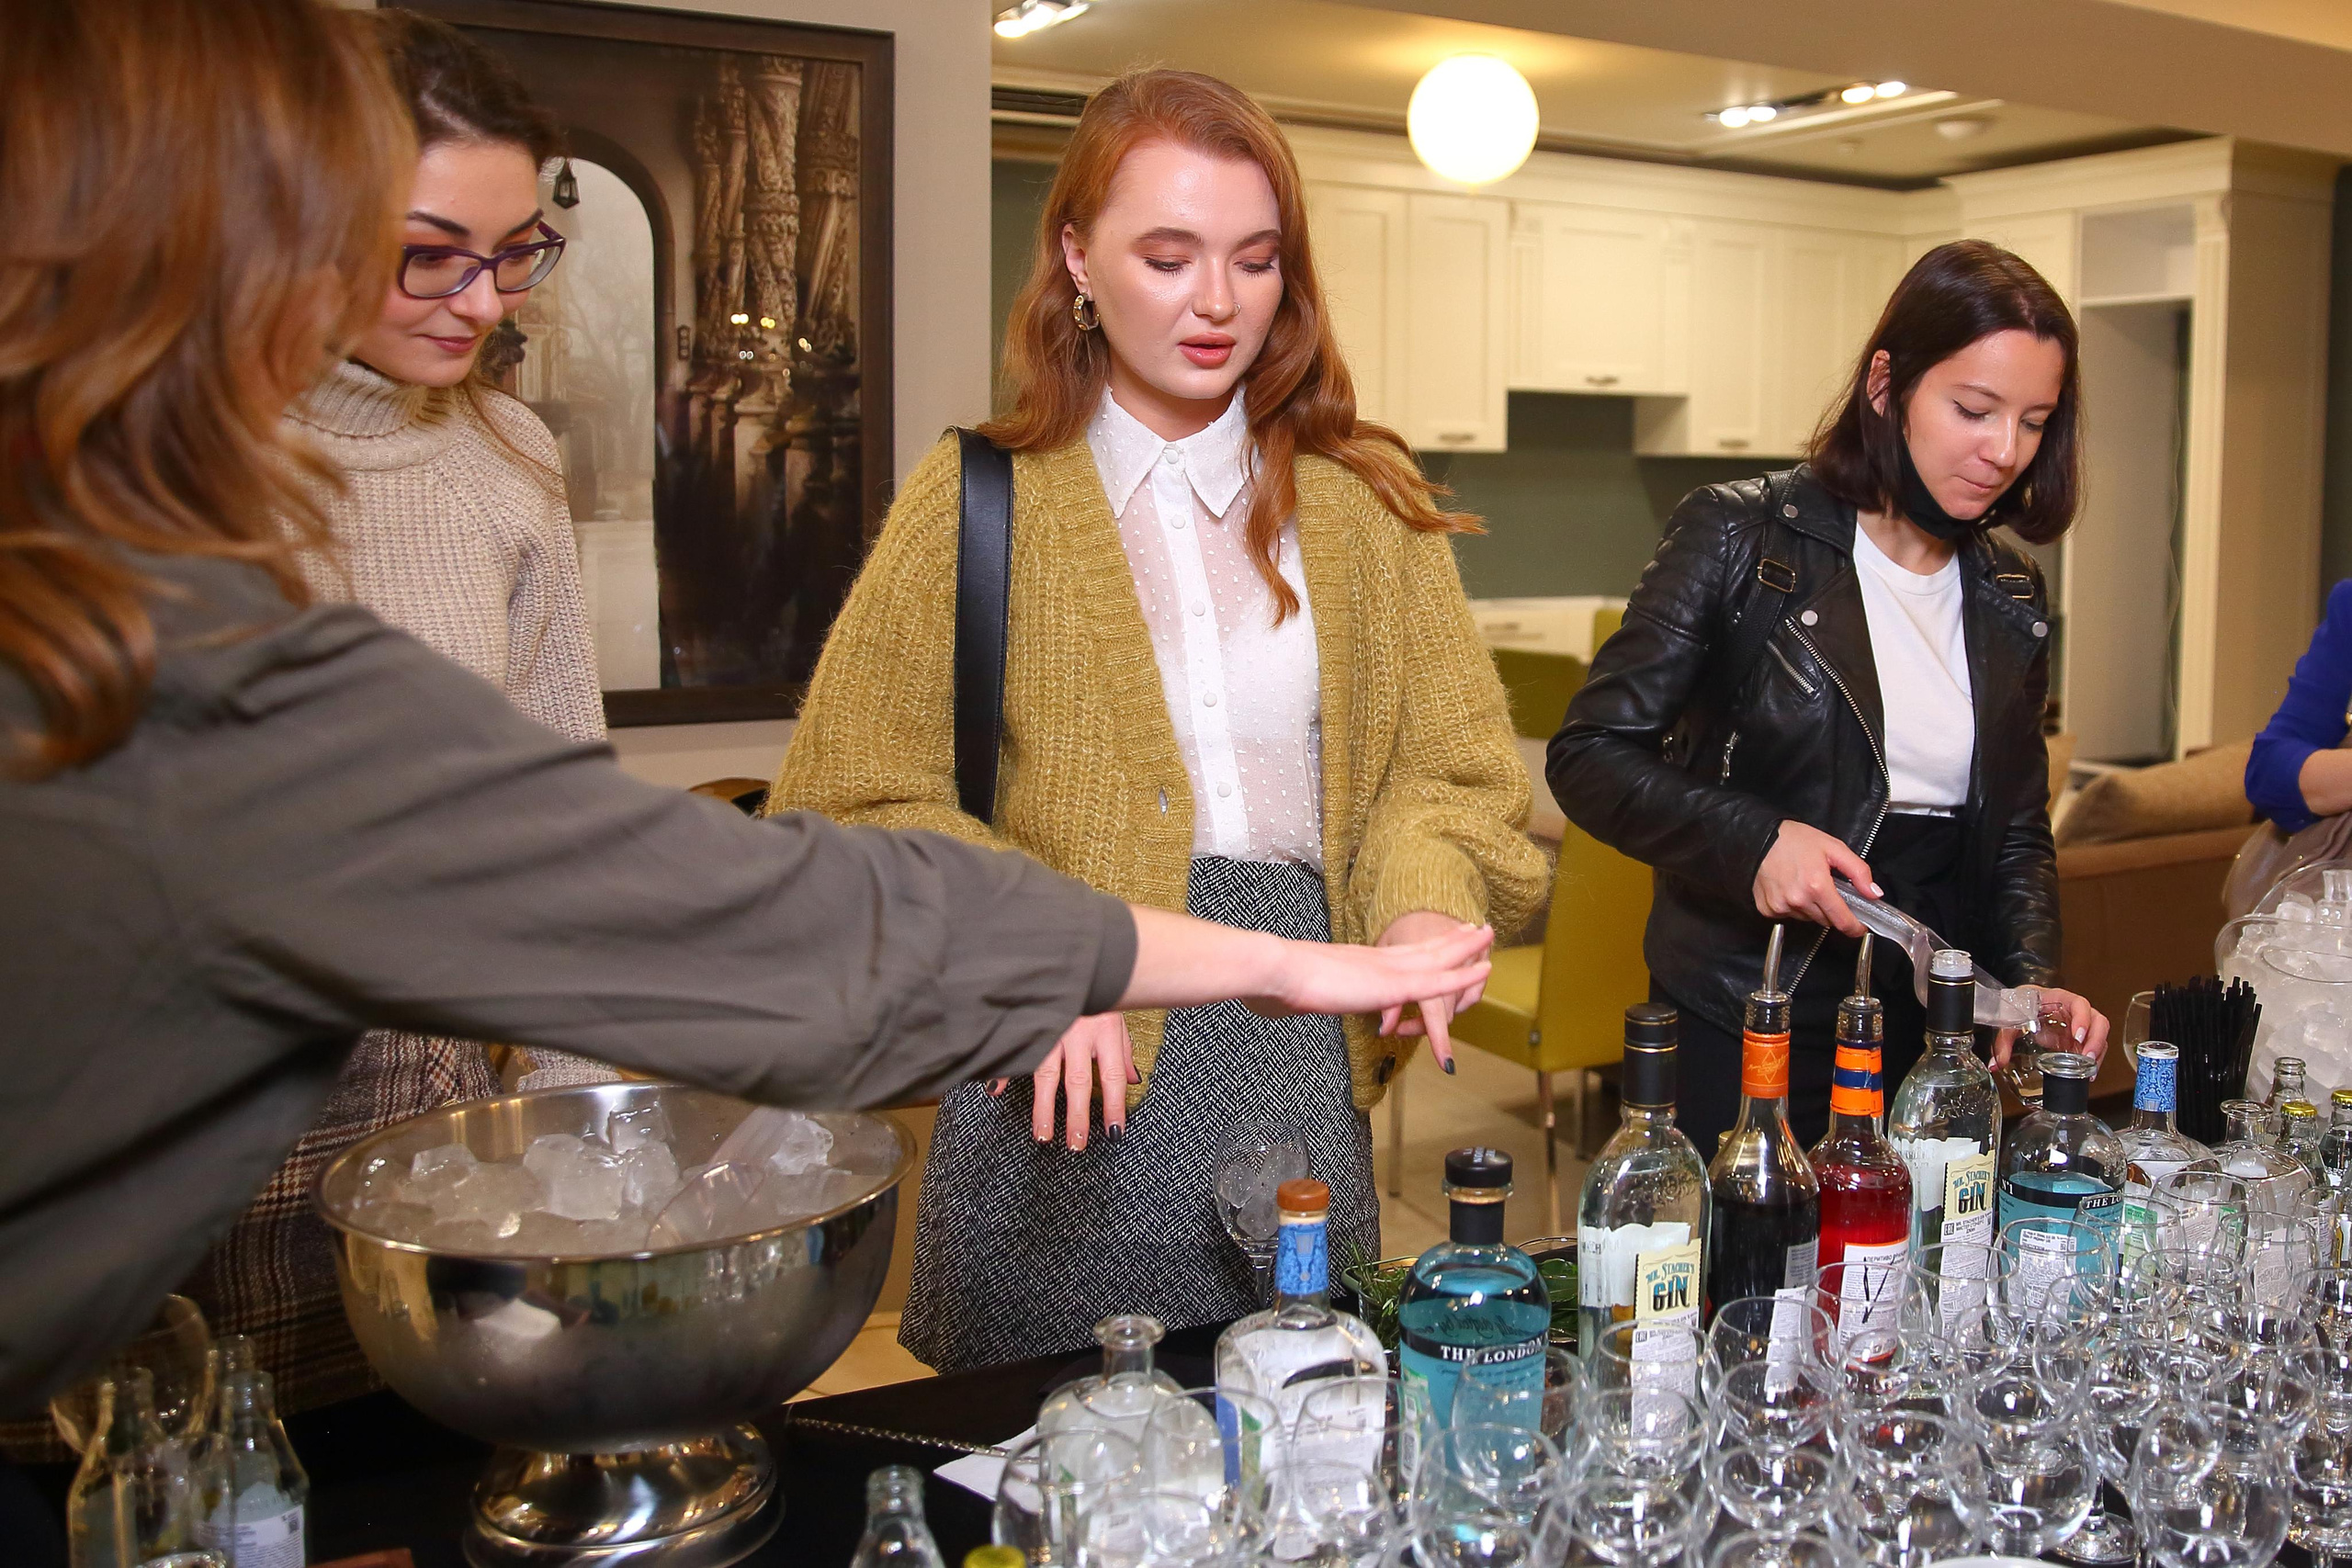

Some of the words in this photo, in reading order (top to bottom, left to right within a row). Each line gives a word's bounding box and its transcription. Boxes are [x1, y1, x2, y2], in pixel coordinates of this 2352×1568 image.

[1958, 1181, 1987, 1214] GIN
[2084, 1197, 2109, 1209] THE
[1653, 1274, 1690, 1312] GIN
[1440, 1345, 1478, 1365] THE
[1483, 1338, 1544, 1363] LONDON
